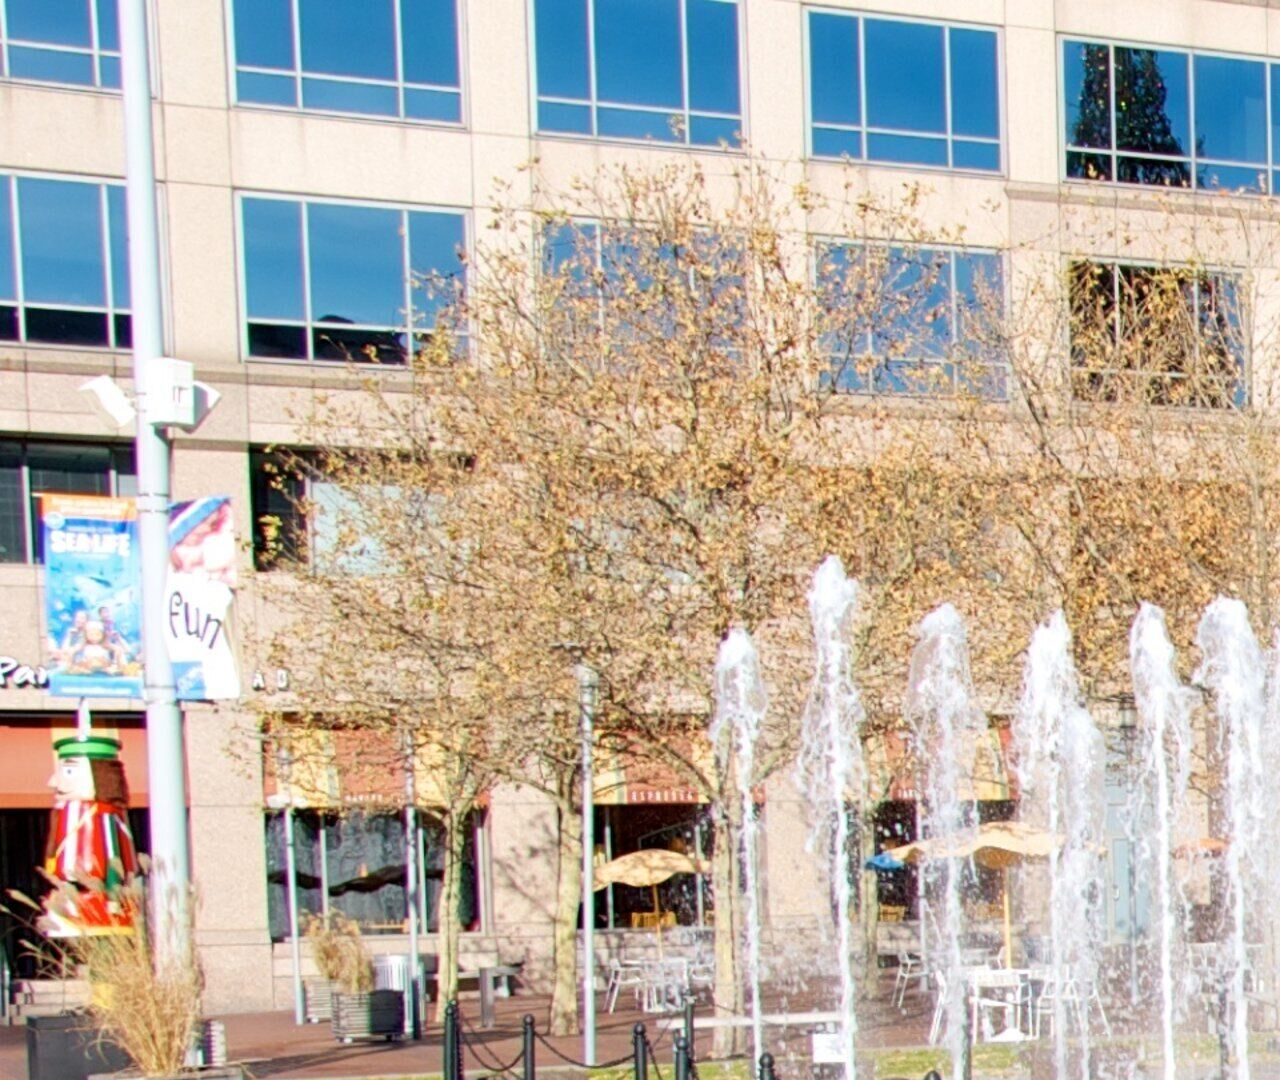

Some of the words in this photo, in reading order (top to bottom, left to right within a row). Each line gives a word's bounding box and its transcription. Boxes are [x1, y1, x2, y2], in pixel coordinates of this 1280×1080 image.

[51, 530, 89, 553] SEA
[92, 533, 131, 557] LIFE
[169, 591, 222, 649] fun
